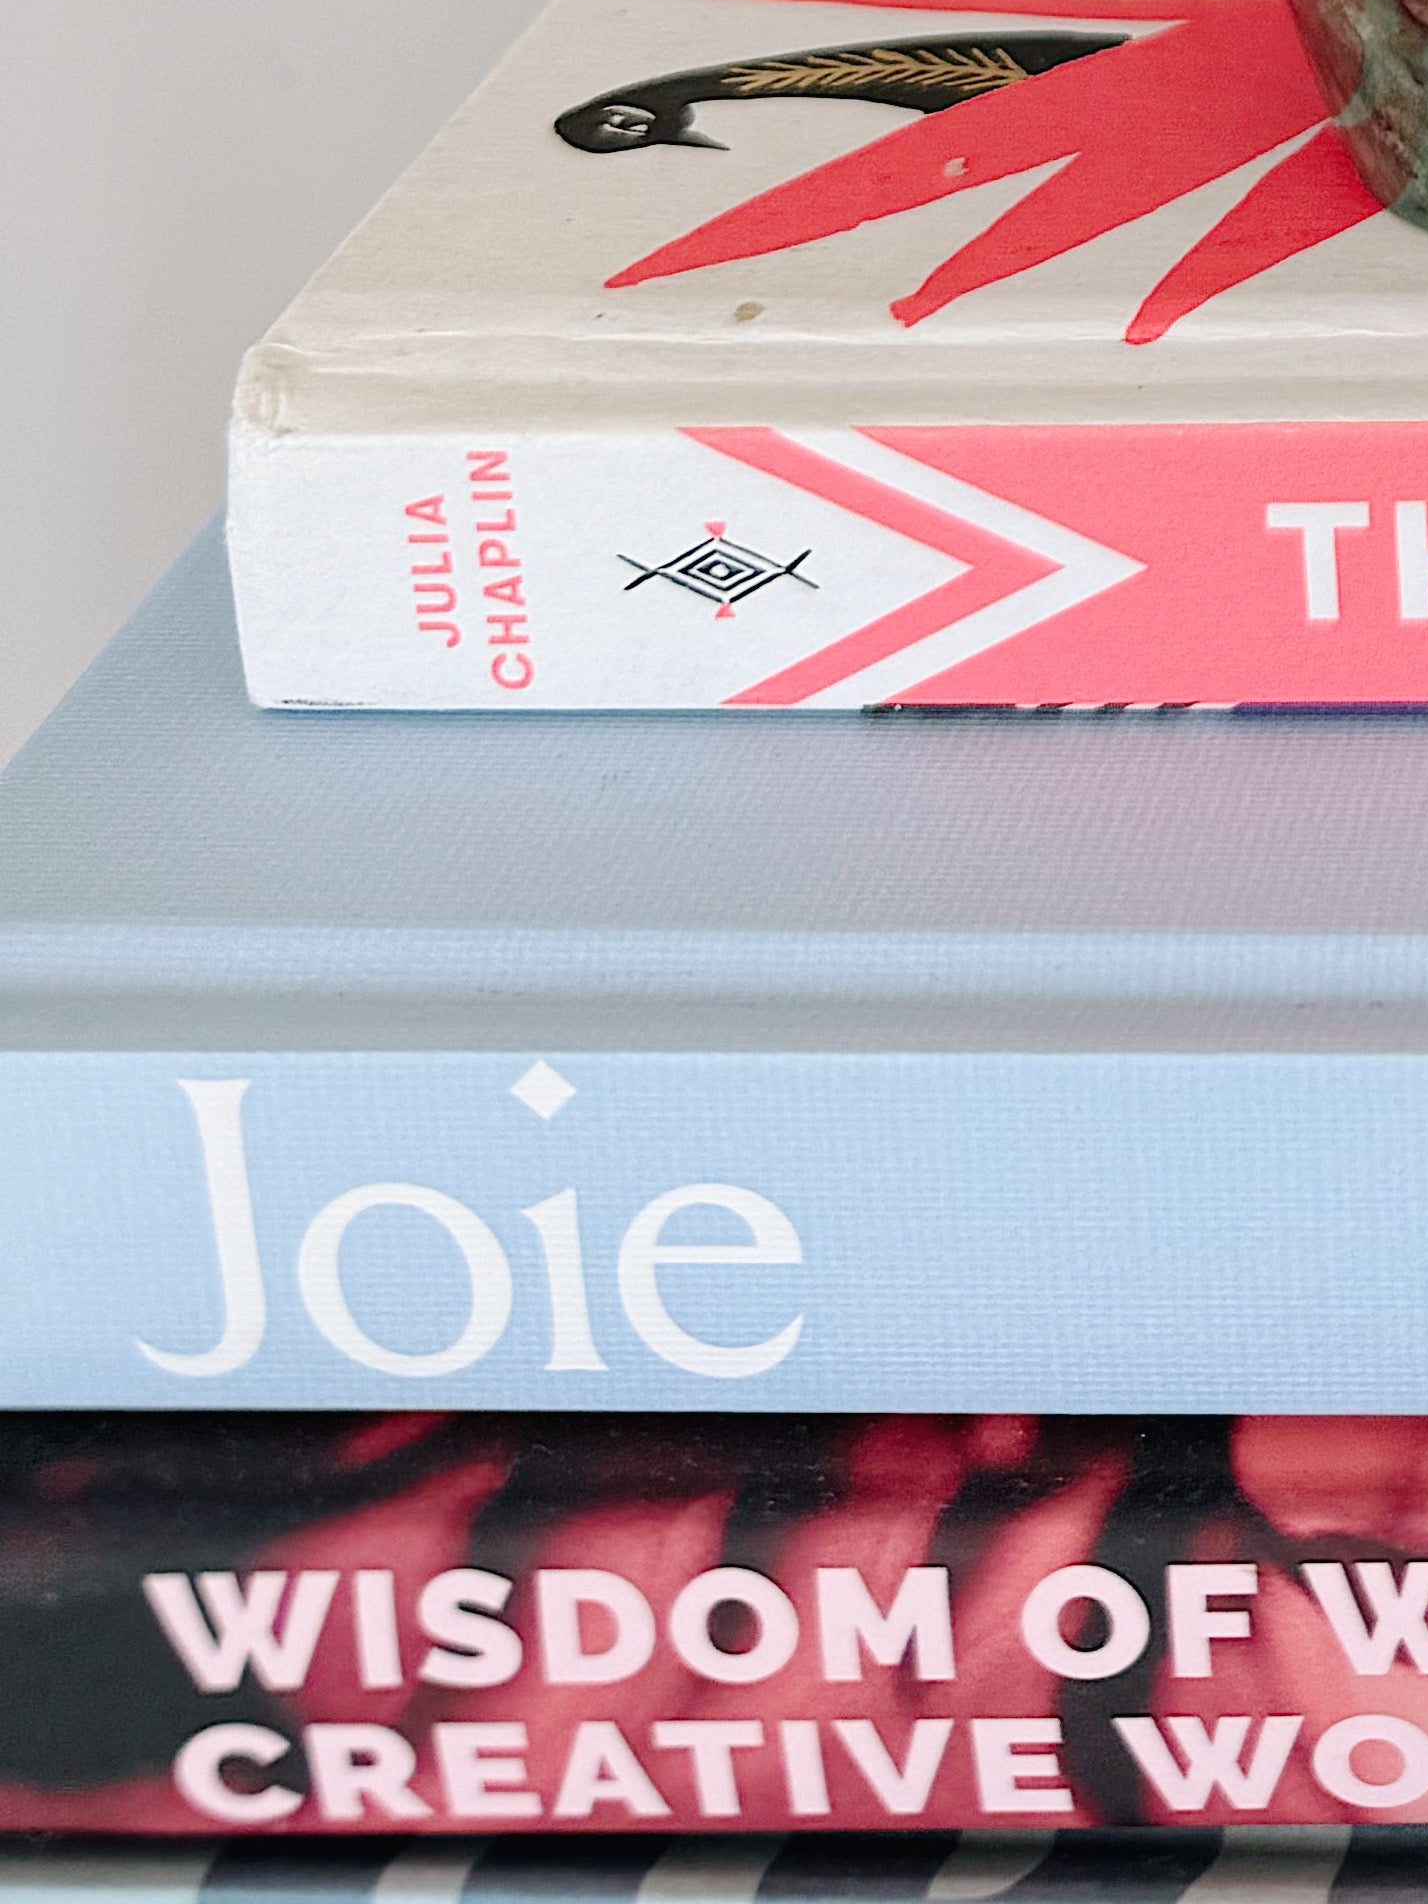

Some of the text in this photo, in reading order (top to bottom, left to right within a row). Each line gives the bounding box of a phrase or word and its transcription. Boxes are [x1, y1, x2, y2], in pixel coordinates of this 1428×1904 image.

[404, 493, 463, 648] JULIA
[467, 449, 535, 691] CHAPLIN
[134, 1059, 804, 1379] Joie
[143, 1566, 957, 1691] WISDOM
[1021, 1562, 1259, 1681] OF
[174, 1717, 1075, 1823] CREATIVE
